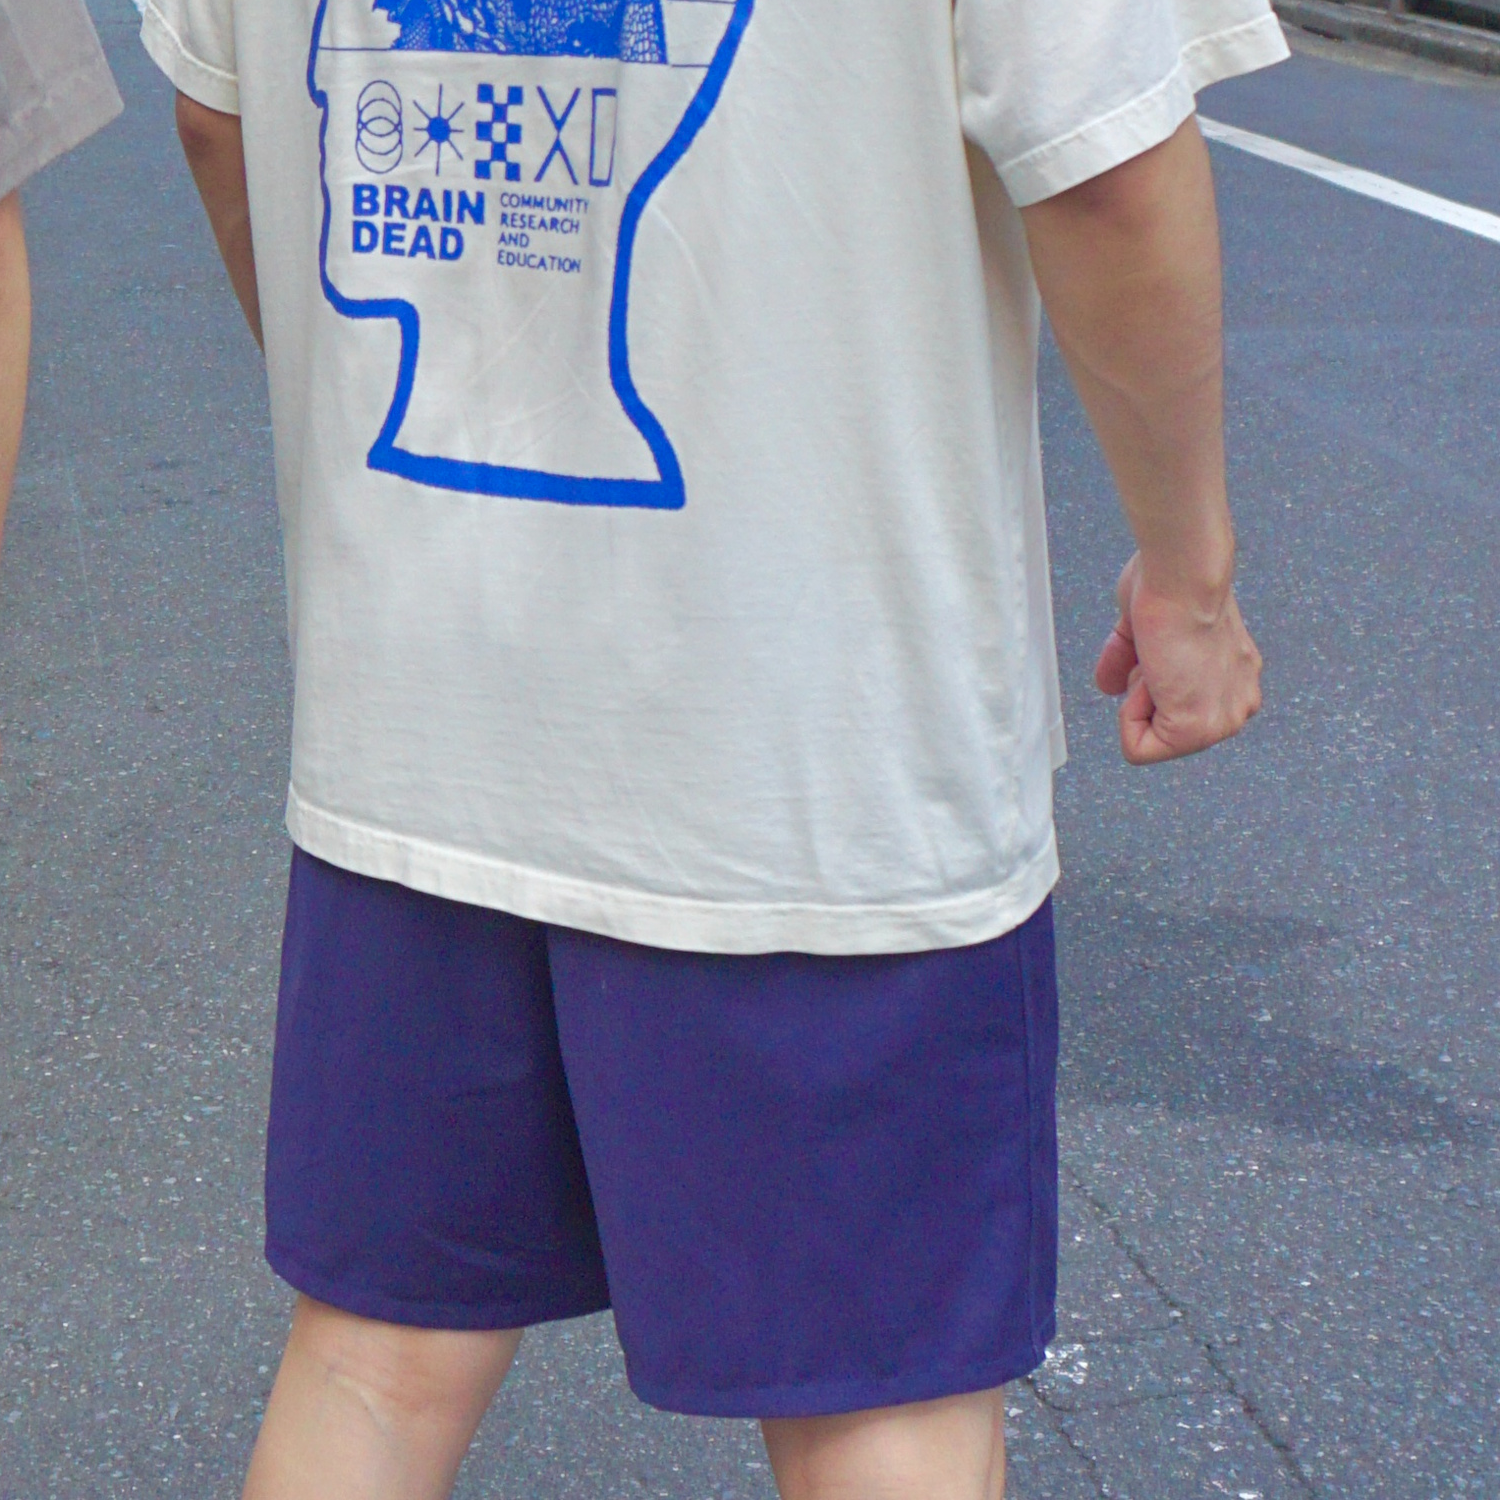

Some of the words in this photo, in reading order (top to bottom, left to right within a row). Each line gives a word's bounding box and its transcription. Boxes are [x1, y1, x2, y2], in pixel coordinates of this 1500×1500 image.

[352, 183, 486, 225] BRAIN
[500, 192, 589, 214] COMMUNITY
[500, 212, 580, 234] RESEARCH
[351, 220, 465, 261] DEAD
[498, 232, 530, 248] AND
[497, 250, 581, 274] EDUCATION
